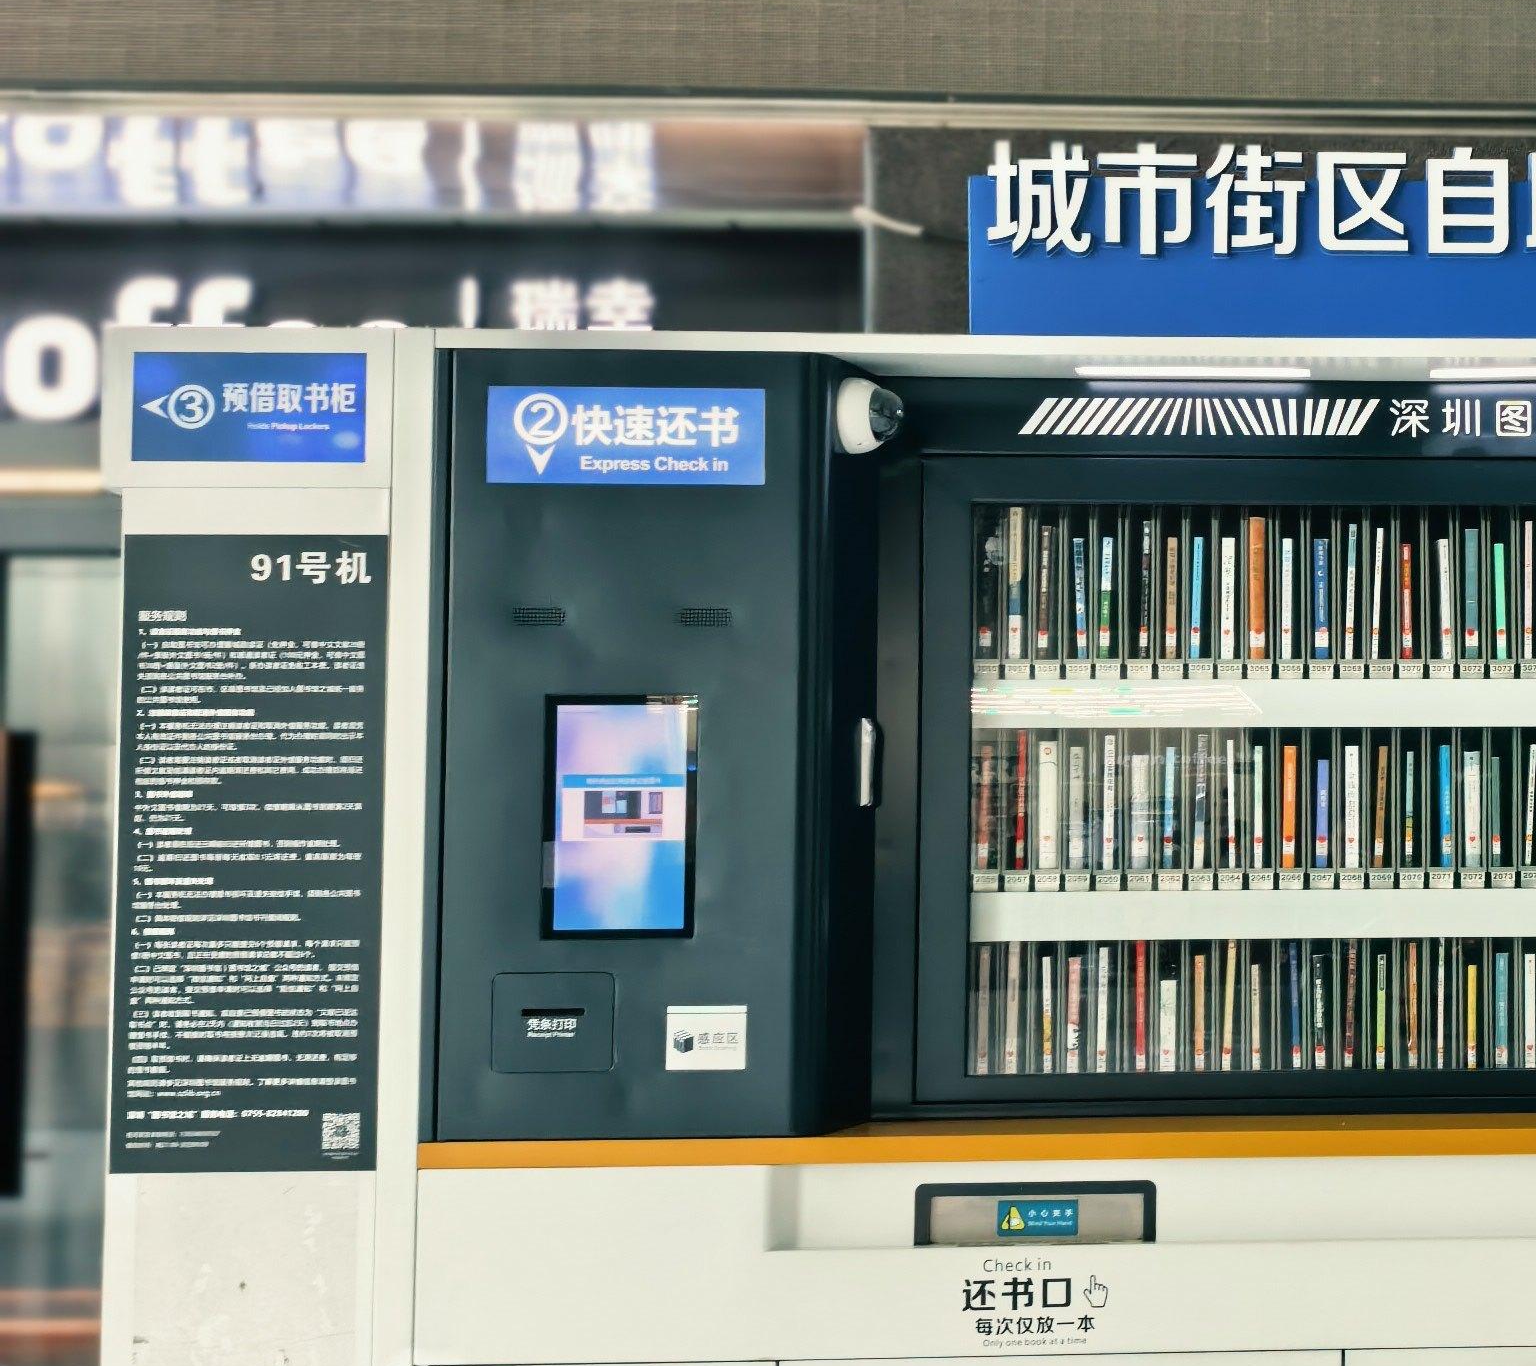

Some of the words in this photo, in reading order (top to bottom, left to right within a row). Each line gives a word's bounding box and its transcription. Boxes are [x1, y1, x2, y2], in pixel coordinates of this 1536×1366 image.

[222, 382, 357, 413] 预借取书柜
[571, 404, 740, 447] 快速还书
[580, 456, 650, 474] Express
[654, 456, 708, 471] Check
[712, 457, 729, 472] in
[250, 551, 372, 585] 91号机
[983, 1258, 1032, 1272] Check
[1037, 1257, 1051, 1271] in
[962, 1277, 1071, 1311] 还书口
[975, 1315, 1095, 1336] 每次仅放一本
[1024, 1338, 1046, 1346] book
